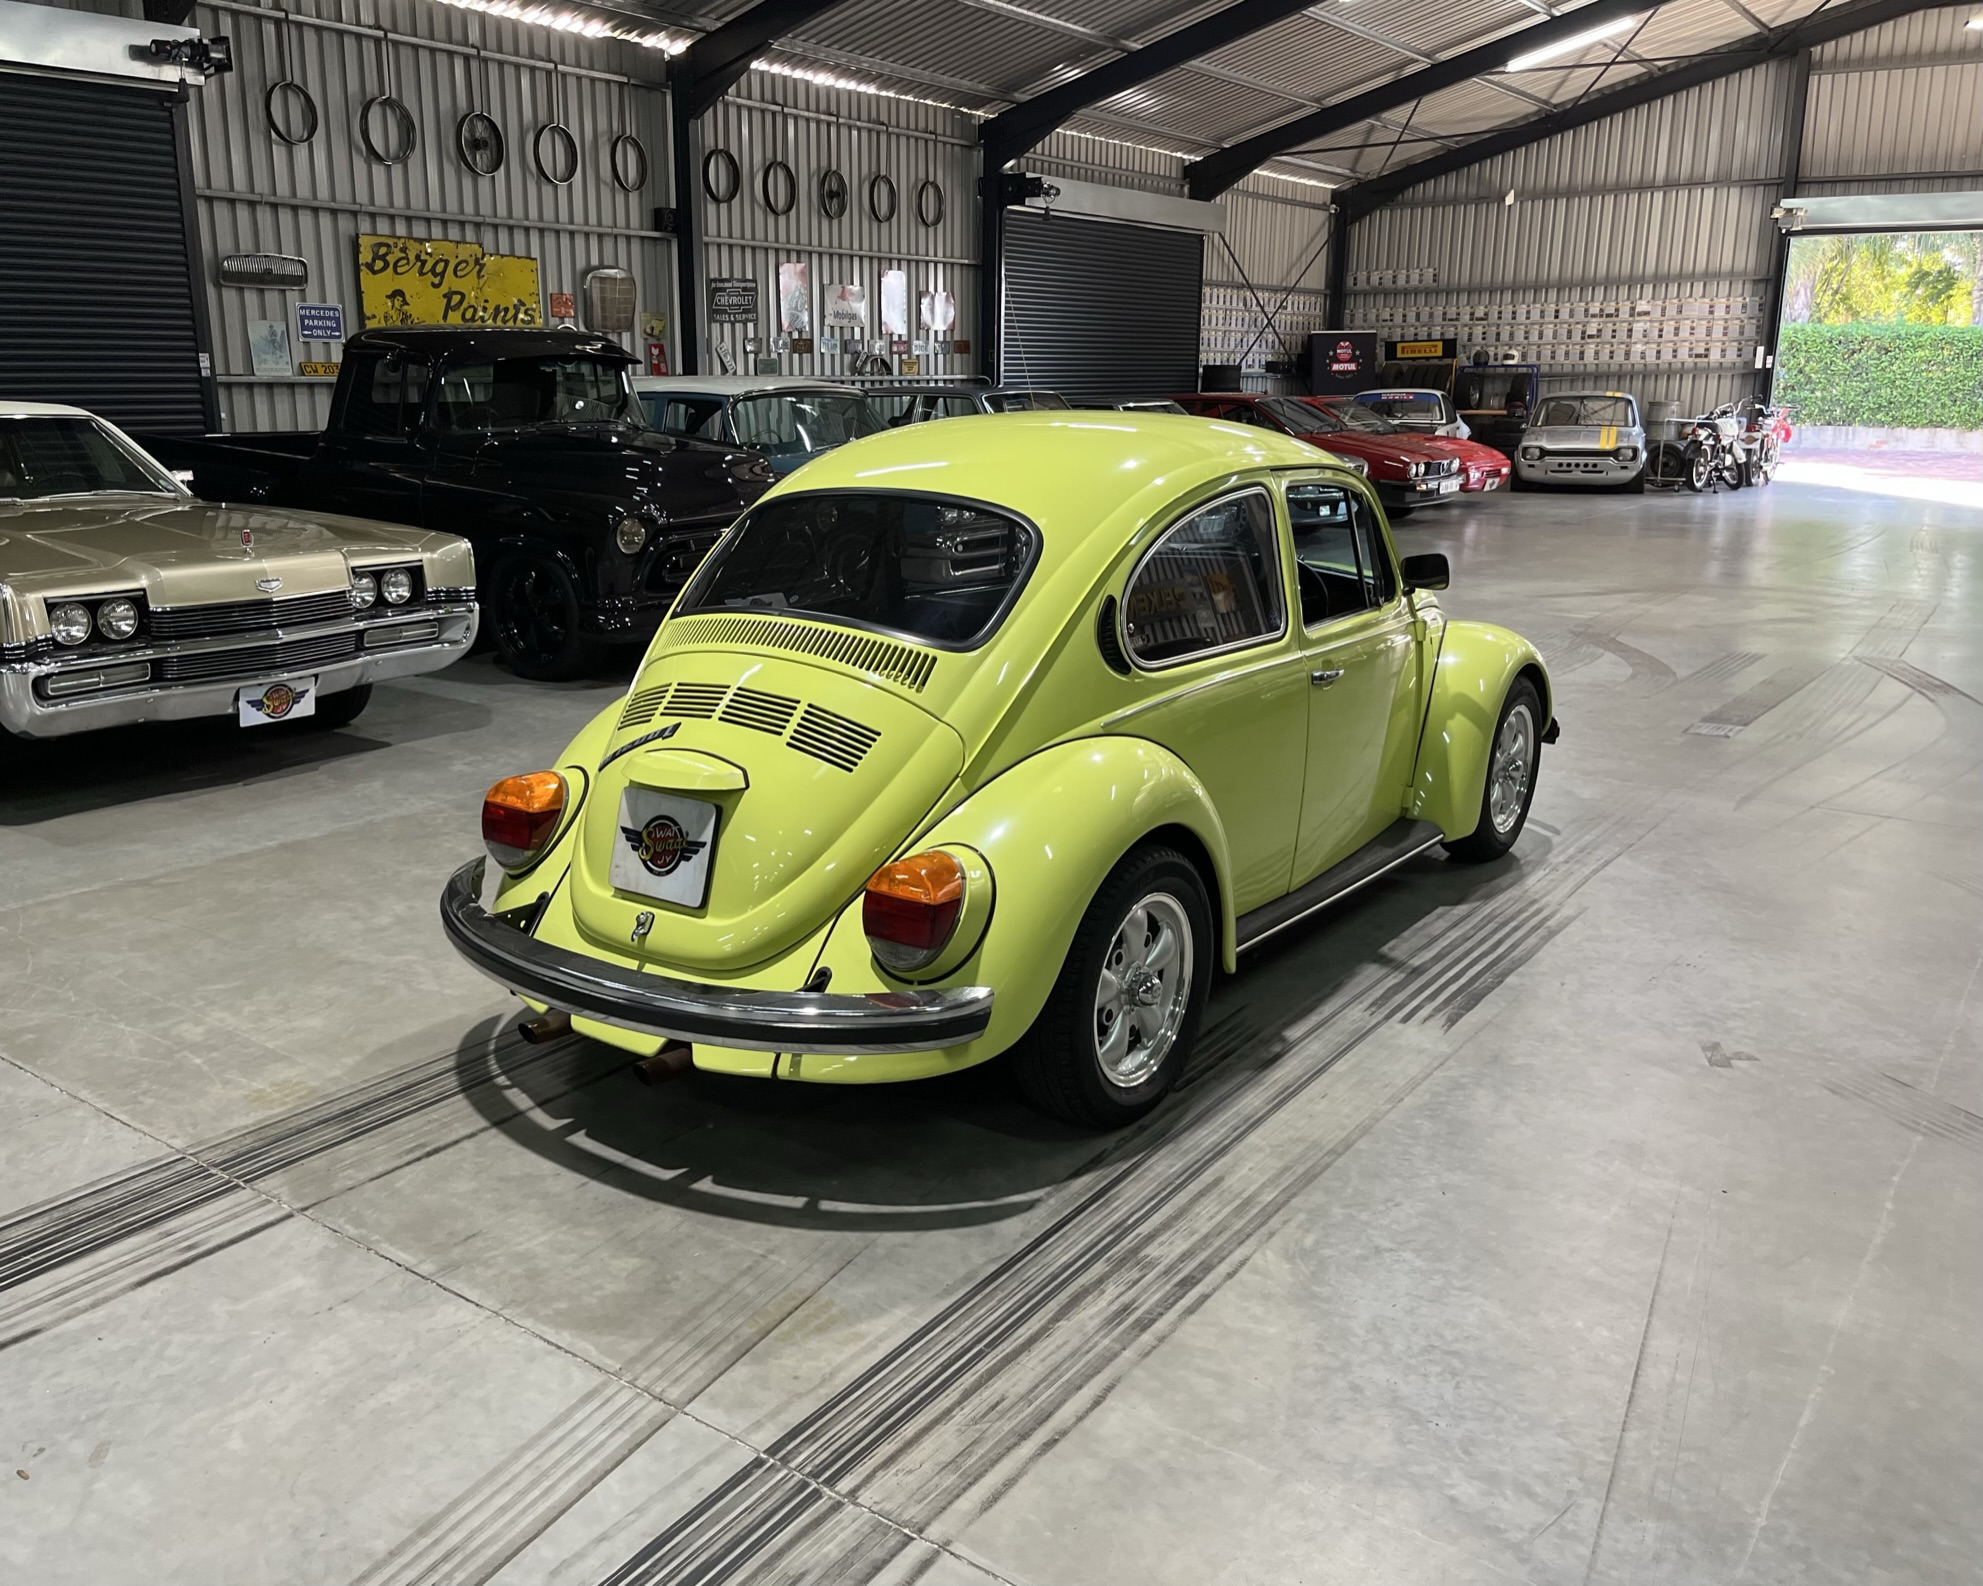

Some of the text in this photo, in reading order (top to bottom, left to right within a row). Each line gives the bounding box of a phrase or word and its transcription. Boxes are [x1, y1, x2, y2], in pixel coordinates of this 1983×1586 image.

[365, 242, 487, 289] Berger
[717, 296, 752, 305] CHEVROLET
[442, 290, 537, 325] Paints
[300, 309, 339, 317] MERCEDES
[833, 310, 857, 323] Mobilgas
[304, 319, 336, 327] PARKING
[1401, 345, 1438, 355] PIRELLI
[304, 364, 318, 374] CW
[657, 855, 672, 864] JY
